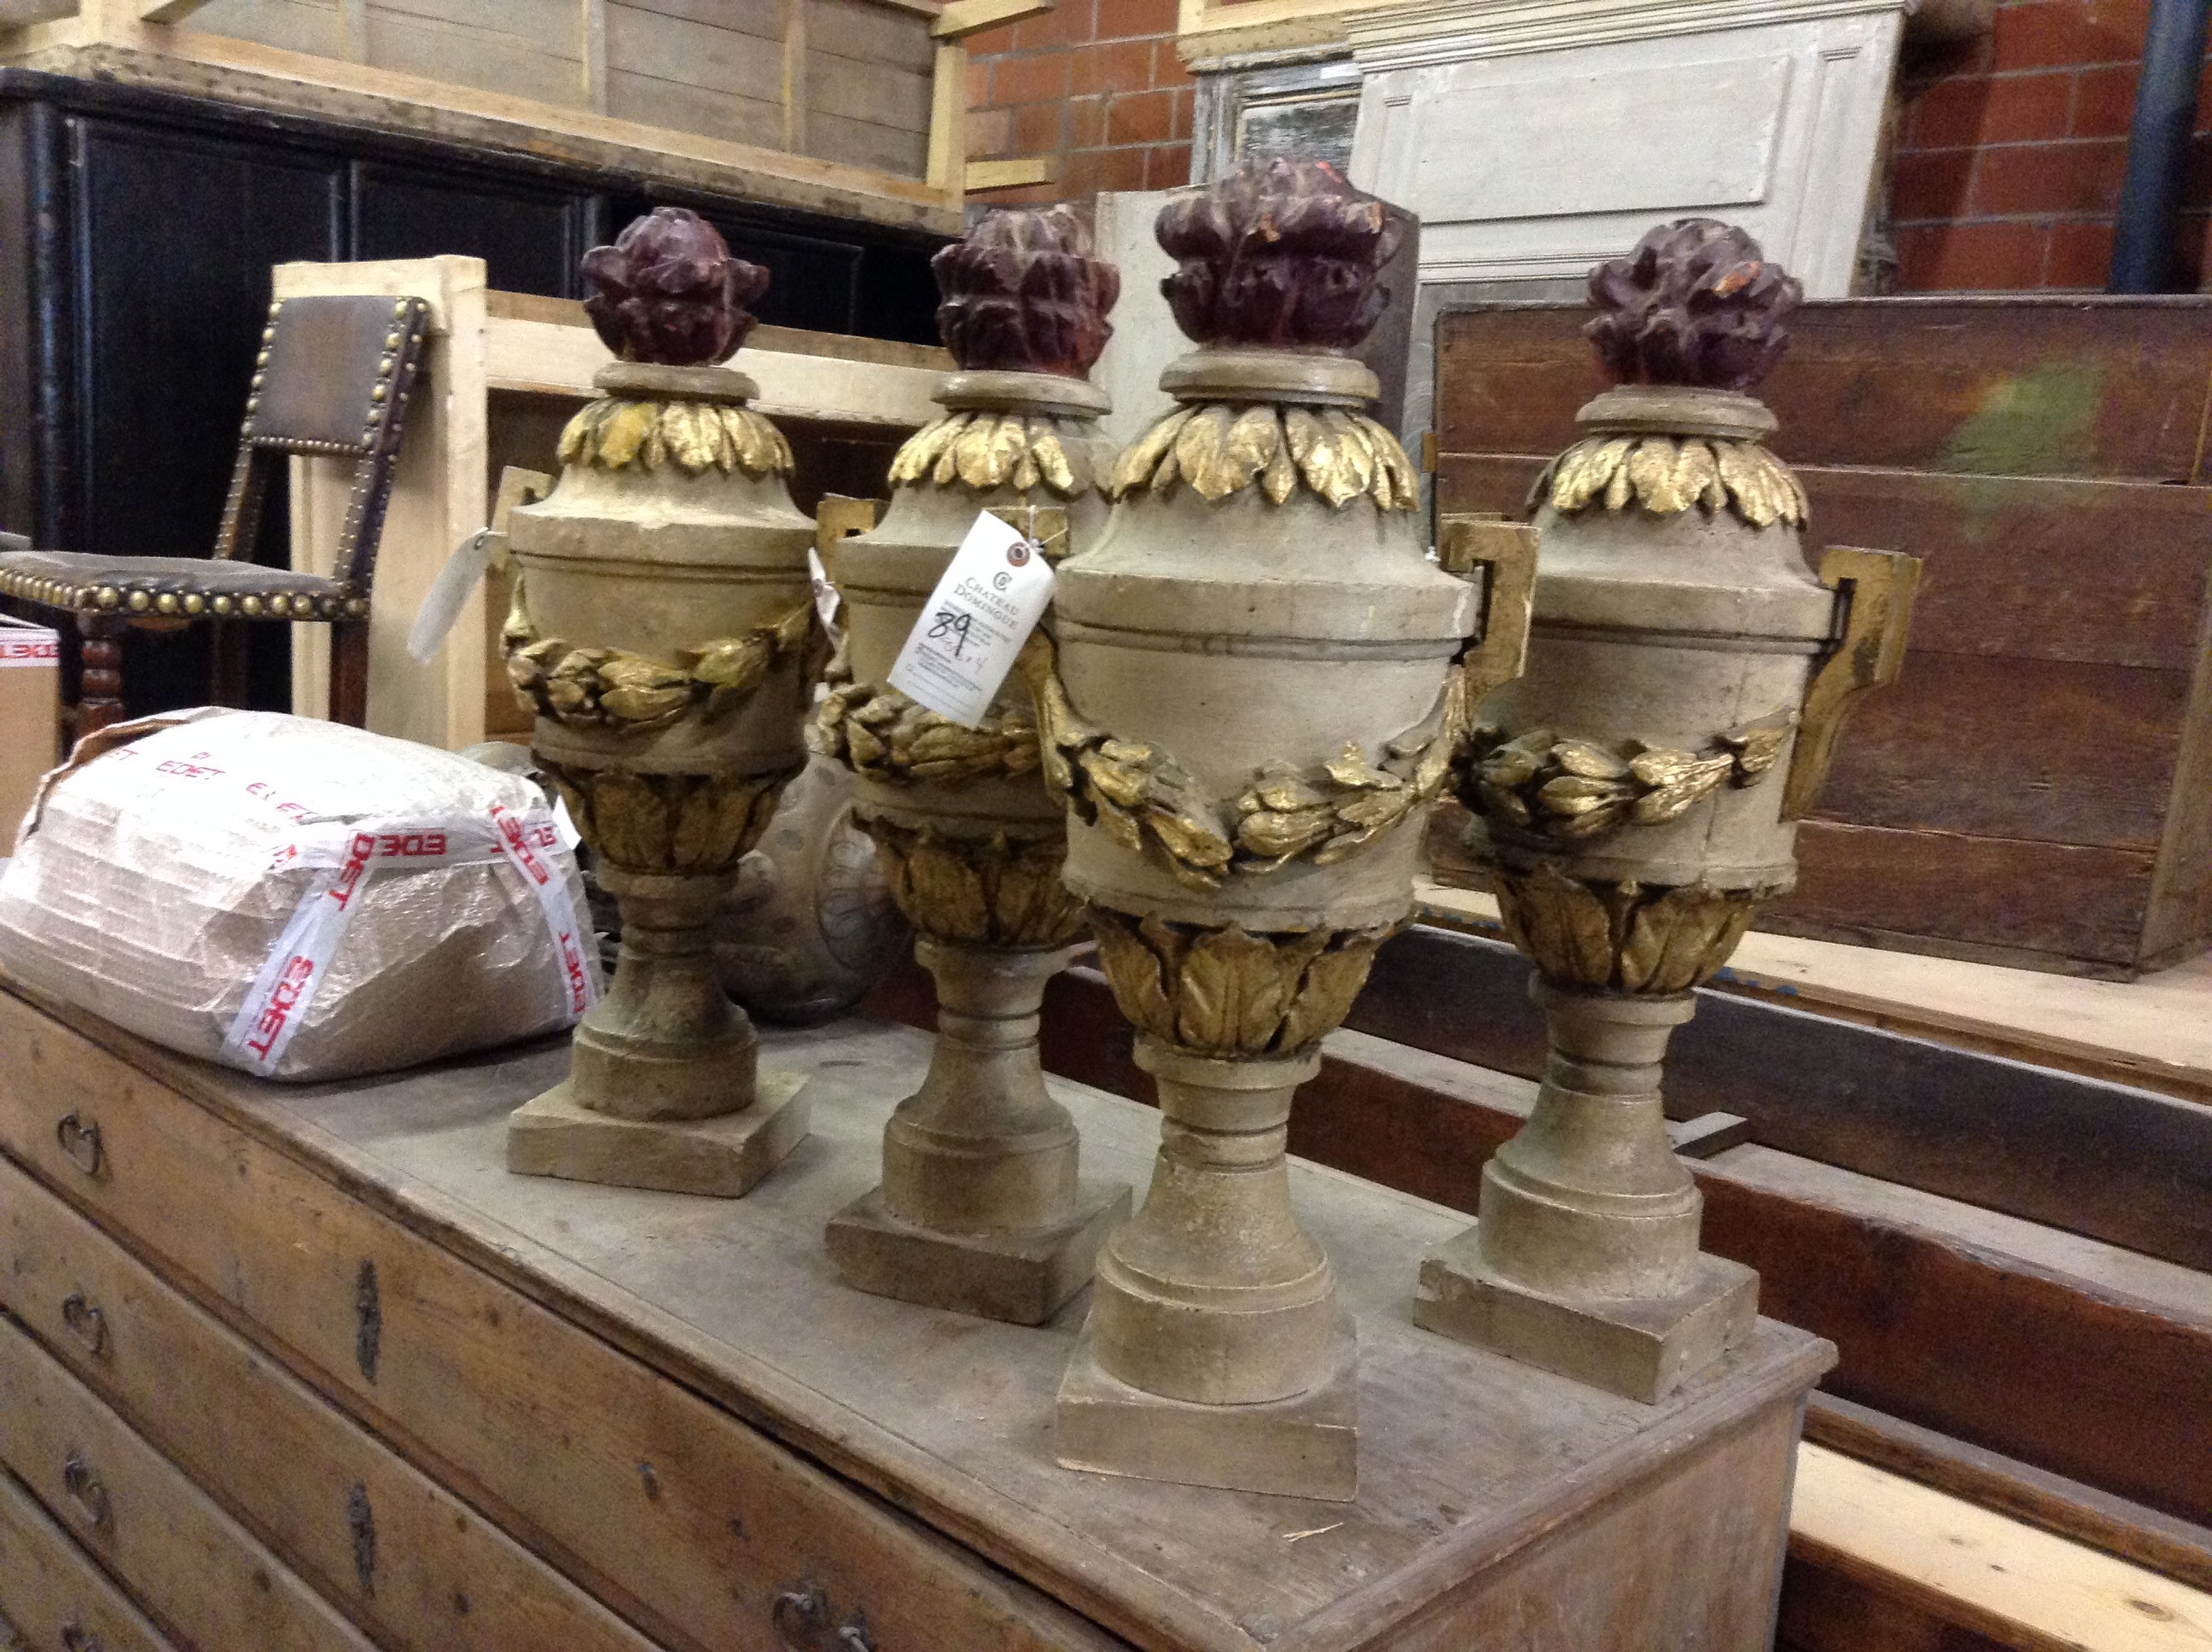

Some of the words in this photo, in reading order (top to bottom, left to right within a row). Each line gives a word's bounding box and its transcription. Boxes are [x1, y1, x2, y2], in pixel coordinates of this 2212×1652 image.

[965, 577, 1020, 615] CHATEAU
[928, 612, 971, 657] 89
[248, 956, 315, 1061] EDET
